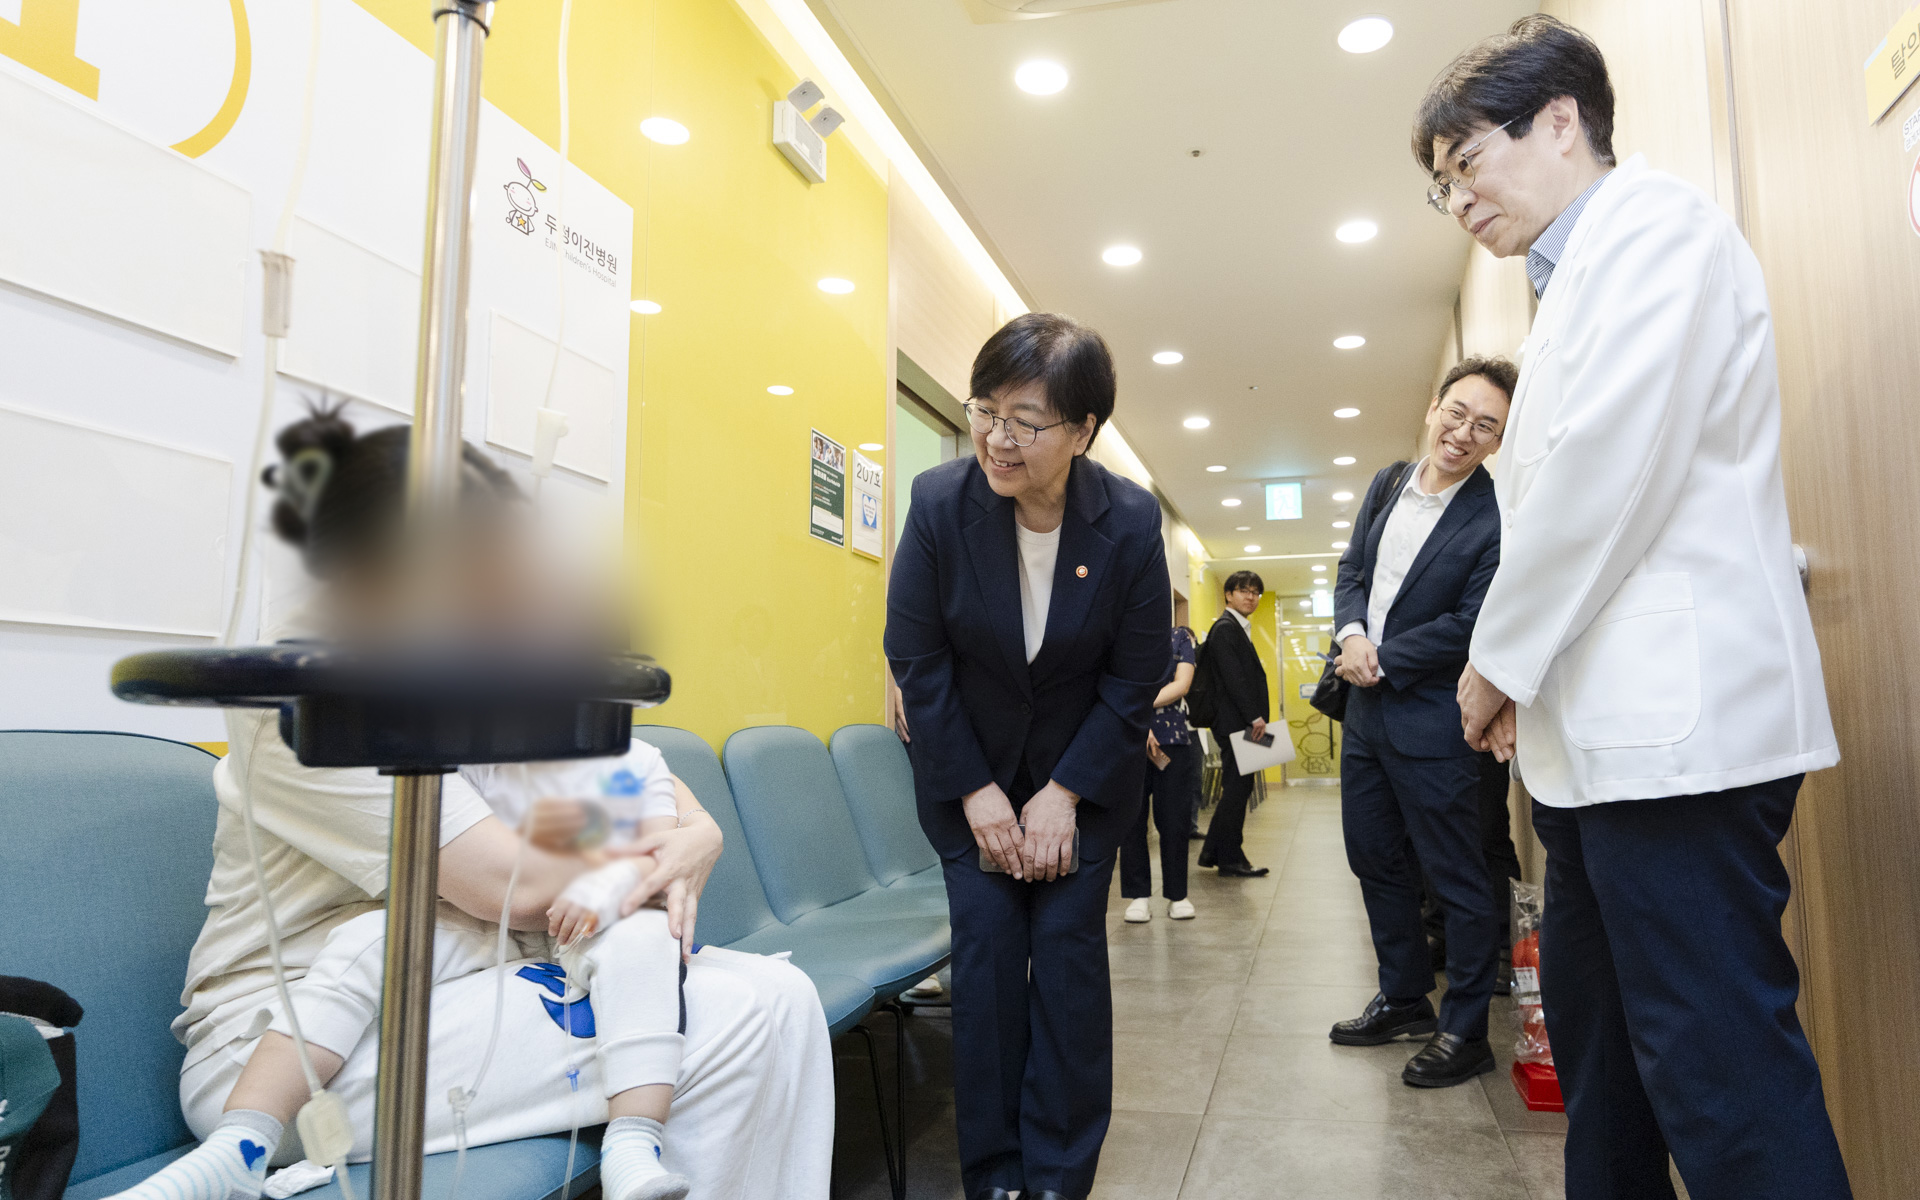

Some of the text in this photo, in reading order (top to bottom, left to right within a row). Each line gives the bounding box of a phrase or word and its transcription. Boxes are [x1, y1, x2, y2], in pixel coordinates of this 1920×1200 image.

[563, 247, 591, 273] hildren's
[592, 267, 617, 288] Hospital
[856, 462, 881, 488] 207호
